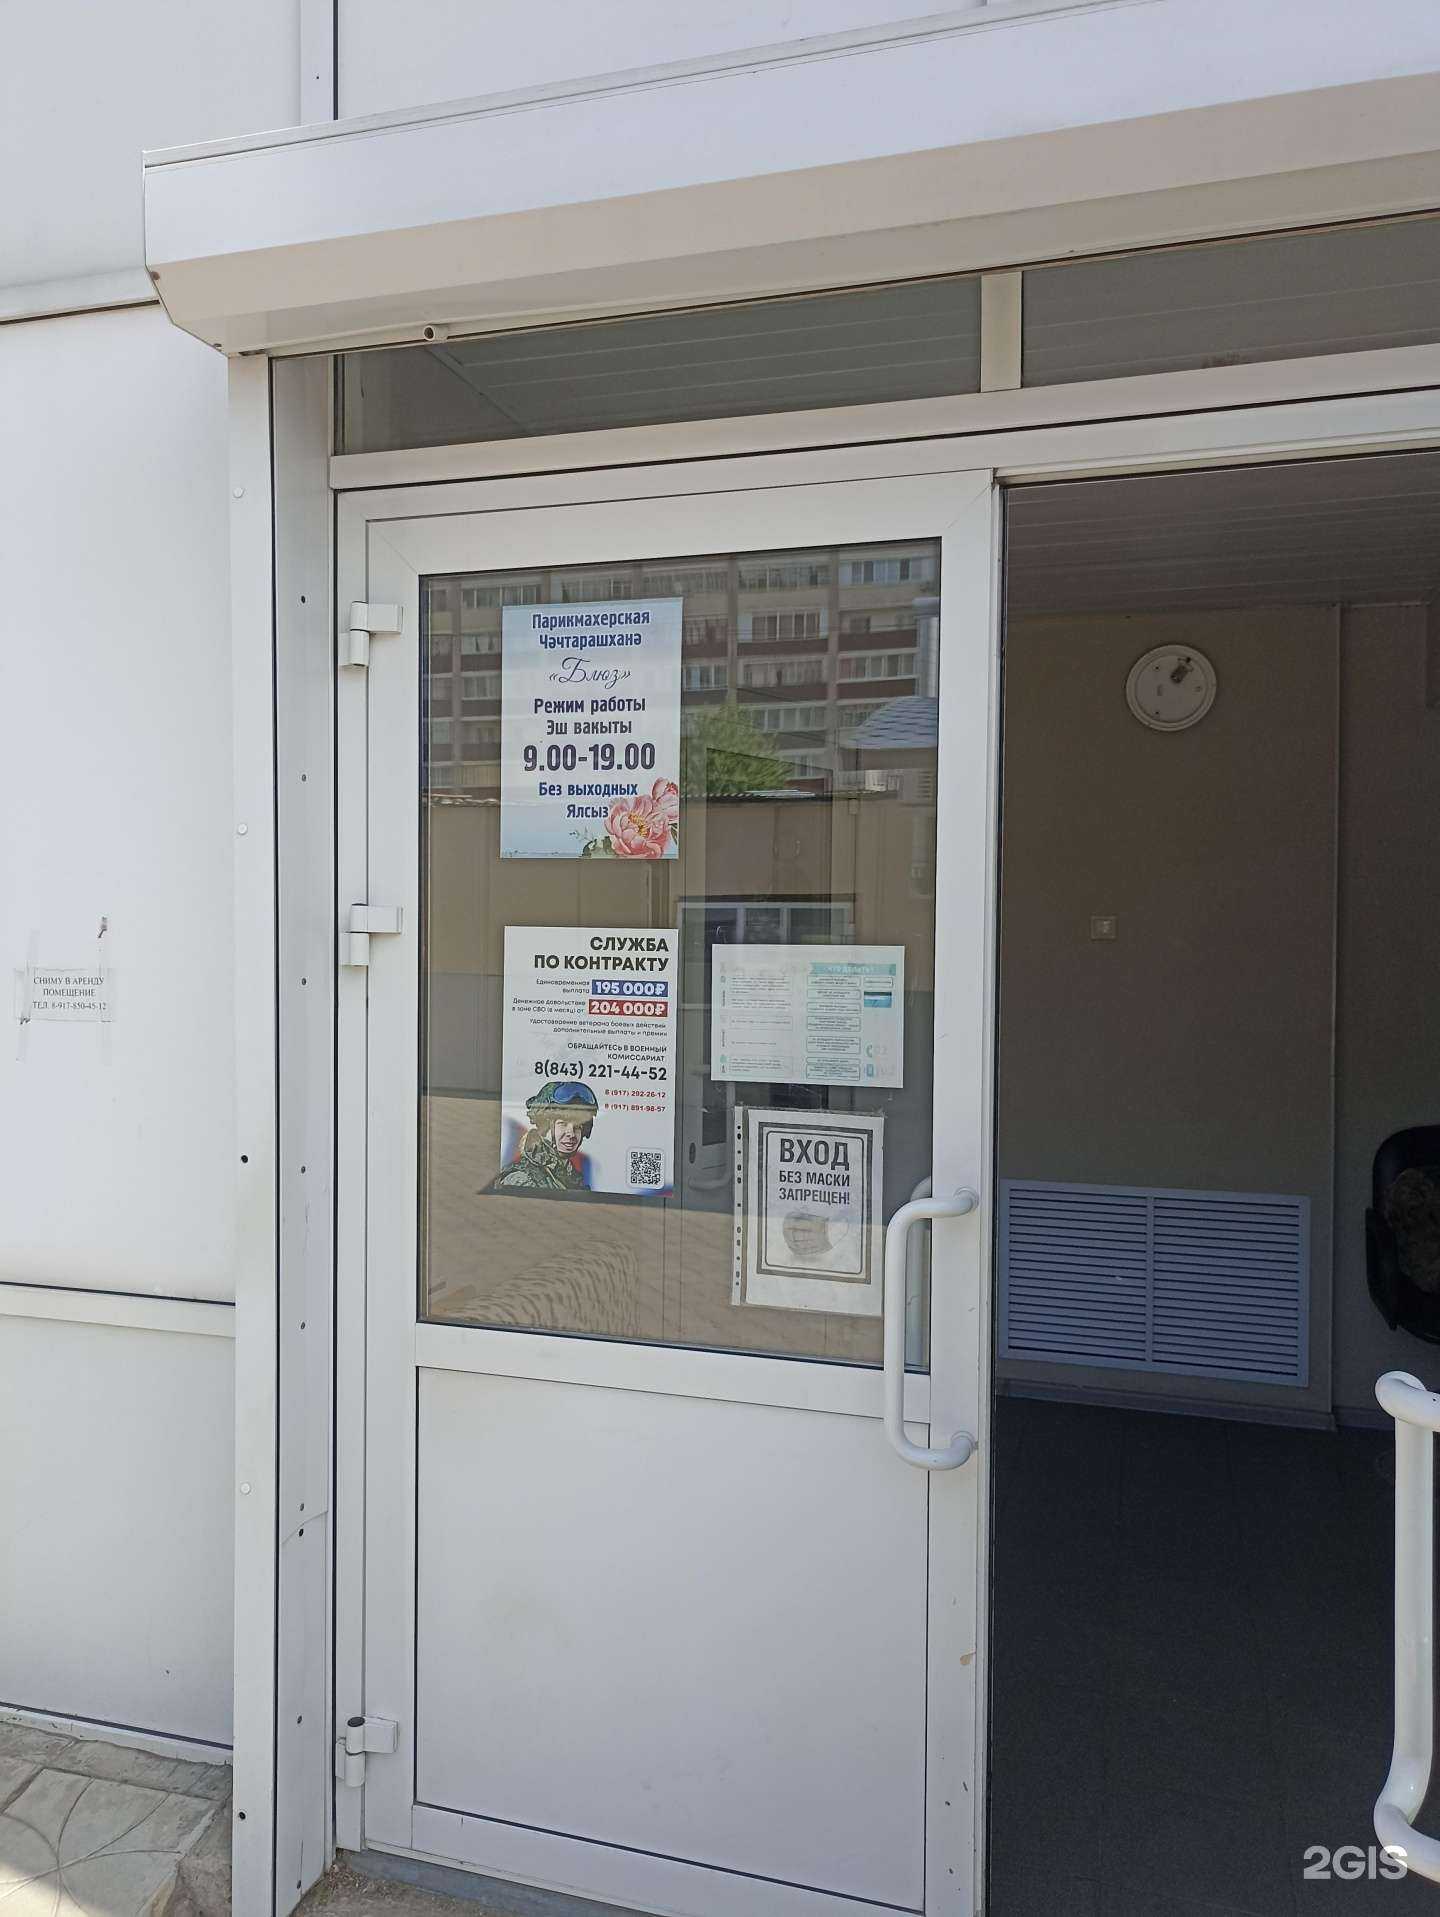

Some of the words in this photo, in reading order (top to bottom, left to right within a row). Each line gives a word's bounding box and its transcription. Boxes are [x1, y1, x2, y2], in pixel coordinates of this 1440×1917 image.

[532, 611, 650, 631] Парикмахерская
[539, 633, 642, 650] Чәчтарашханә
[549, 657, 632, 689] «Блюз»
[534, 698, 584, 714] Режим
[590, 696, 646, 715] работы
[546, 720, 568, 735] Эш
[574, 720, 632, 735] вакыты
[523, 743, 656, 772] 9.00-19.00
[539, 782, 562, 796] Без
[567, 783, 638, 798] выходных
[566, 804, 609, 819] Ялсыз
[590, 936, 669, 952] СЛУЖБА
[534, 954, 560, 969] ПО
[565, 955, 669, 972] КОНТРАКТУ
[33, 976, 62, 985] СНИМУ
[65, 977, 71, 985] В
[73, 976, 104, 985] АРЕНДУ
[595, 981, 621, 995] 195
[43, 988, 96, 997] ПОМЕЩЕНИЕ
[590, 1001, 621, 1015] 204
[567, 1042, 623, 1051] ОБРАЩАЙТЕСЬ
[607, 1053, 665, 1062] КОМИССАРИАТ
[534, 1059, 584, 1079] 8(843)
[588, 1064, 667, 1081] 221-44-52
[779, 1138, 850, 1171] ВХОД
[779, 1170, 802, 1184] БЕЗ
[806, 1172, 850, 1187] МАСКИ
[779, 1187, 850, 1205] ЗАПРЕЩЕН!
